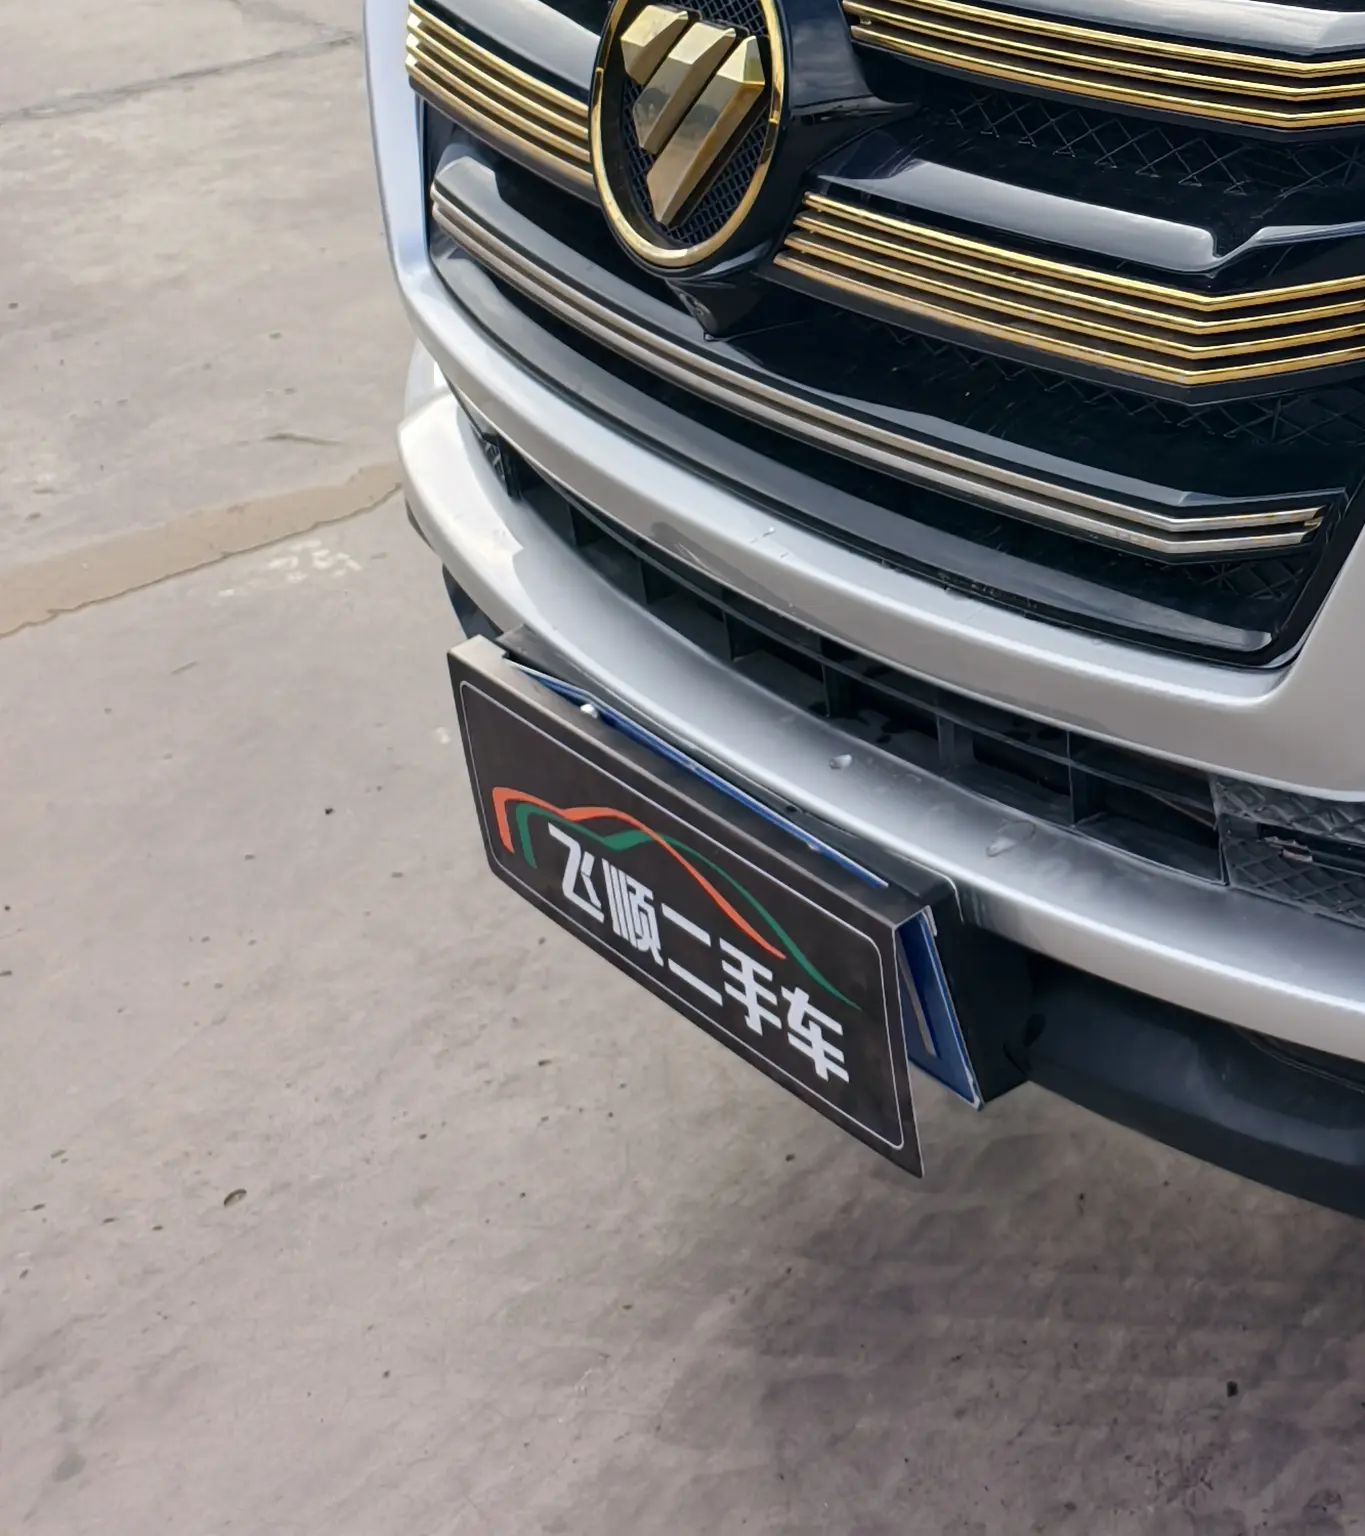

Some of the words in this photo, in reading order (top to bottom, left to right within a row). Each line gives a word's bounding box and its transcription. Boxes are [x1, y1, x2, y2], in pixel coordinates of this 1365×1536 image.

[548, 823, 850, 1083] 飞顺二手车
